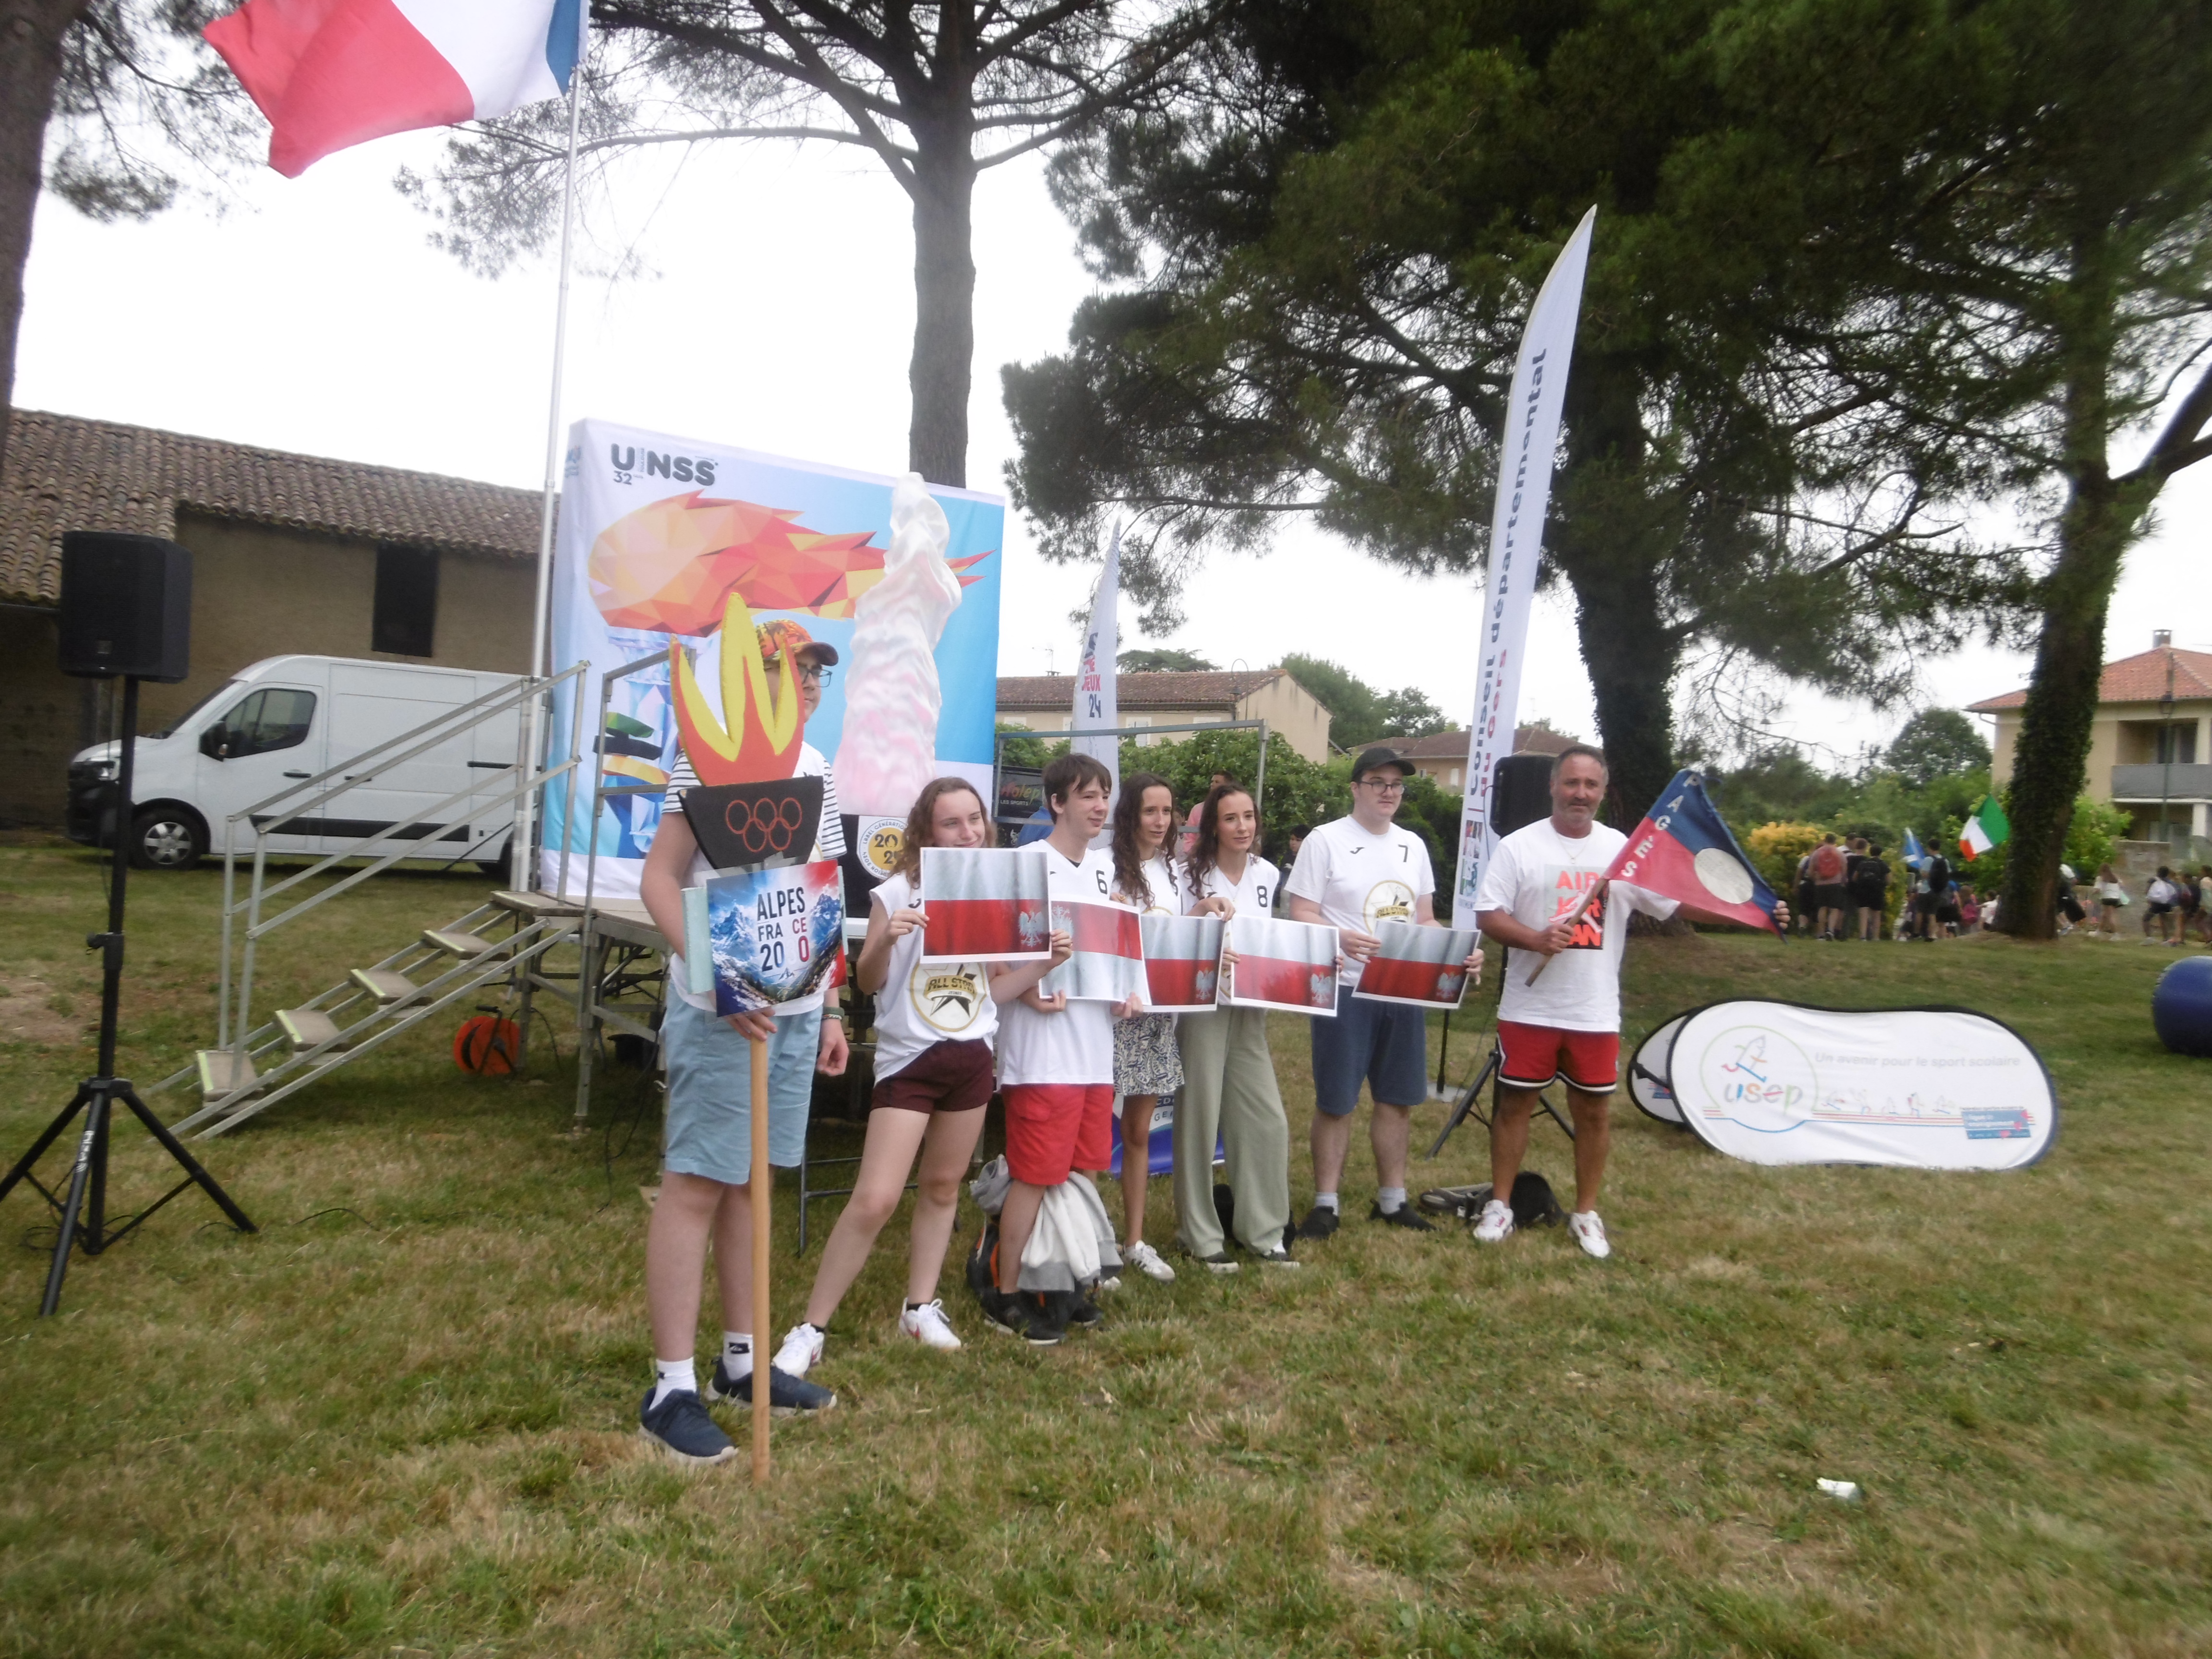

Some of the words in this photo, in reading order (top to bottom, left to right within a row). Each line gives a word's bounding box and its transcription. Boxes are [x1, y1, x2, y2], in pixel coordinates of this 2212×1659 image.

[613, 470, 632, 485] 32
[1470, 654, 1495, 796] Conseil
[1491, 348, 1547, 643] départemental
[1089, 694, 1101, 718] 24
[1488, 649, 1506, 739] Gers
[863, 829, 875, 844] LABEL
[874, 820, 907, 830] GÉNÉRATIO
[1398, 844, 1408, 863] 7
[1096, 869, 1108, 895] 6
[757, 887, 805, 921] ALPES
[1257, 885, 1267, 908] 8
[927, 977, 949, 991] ALL
[1815, 1052, 1834, 1062] Un
[1837, 1055, 1878, 1065] avenir
[1881, 1057, 1913, 1068] pour
[1916, 1056, 1928, 1066] le
[1931, 1056, 1966, 1068] sport
[1969, 1055, 2020, 1066] scolaire
[1724, 1082, 1803, 1115] usep
[1154, 1110, 1173, 1121] GE
